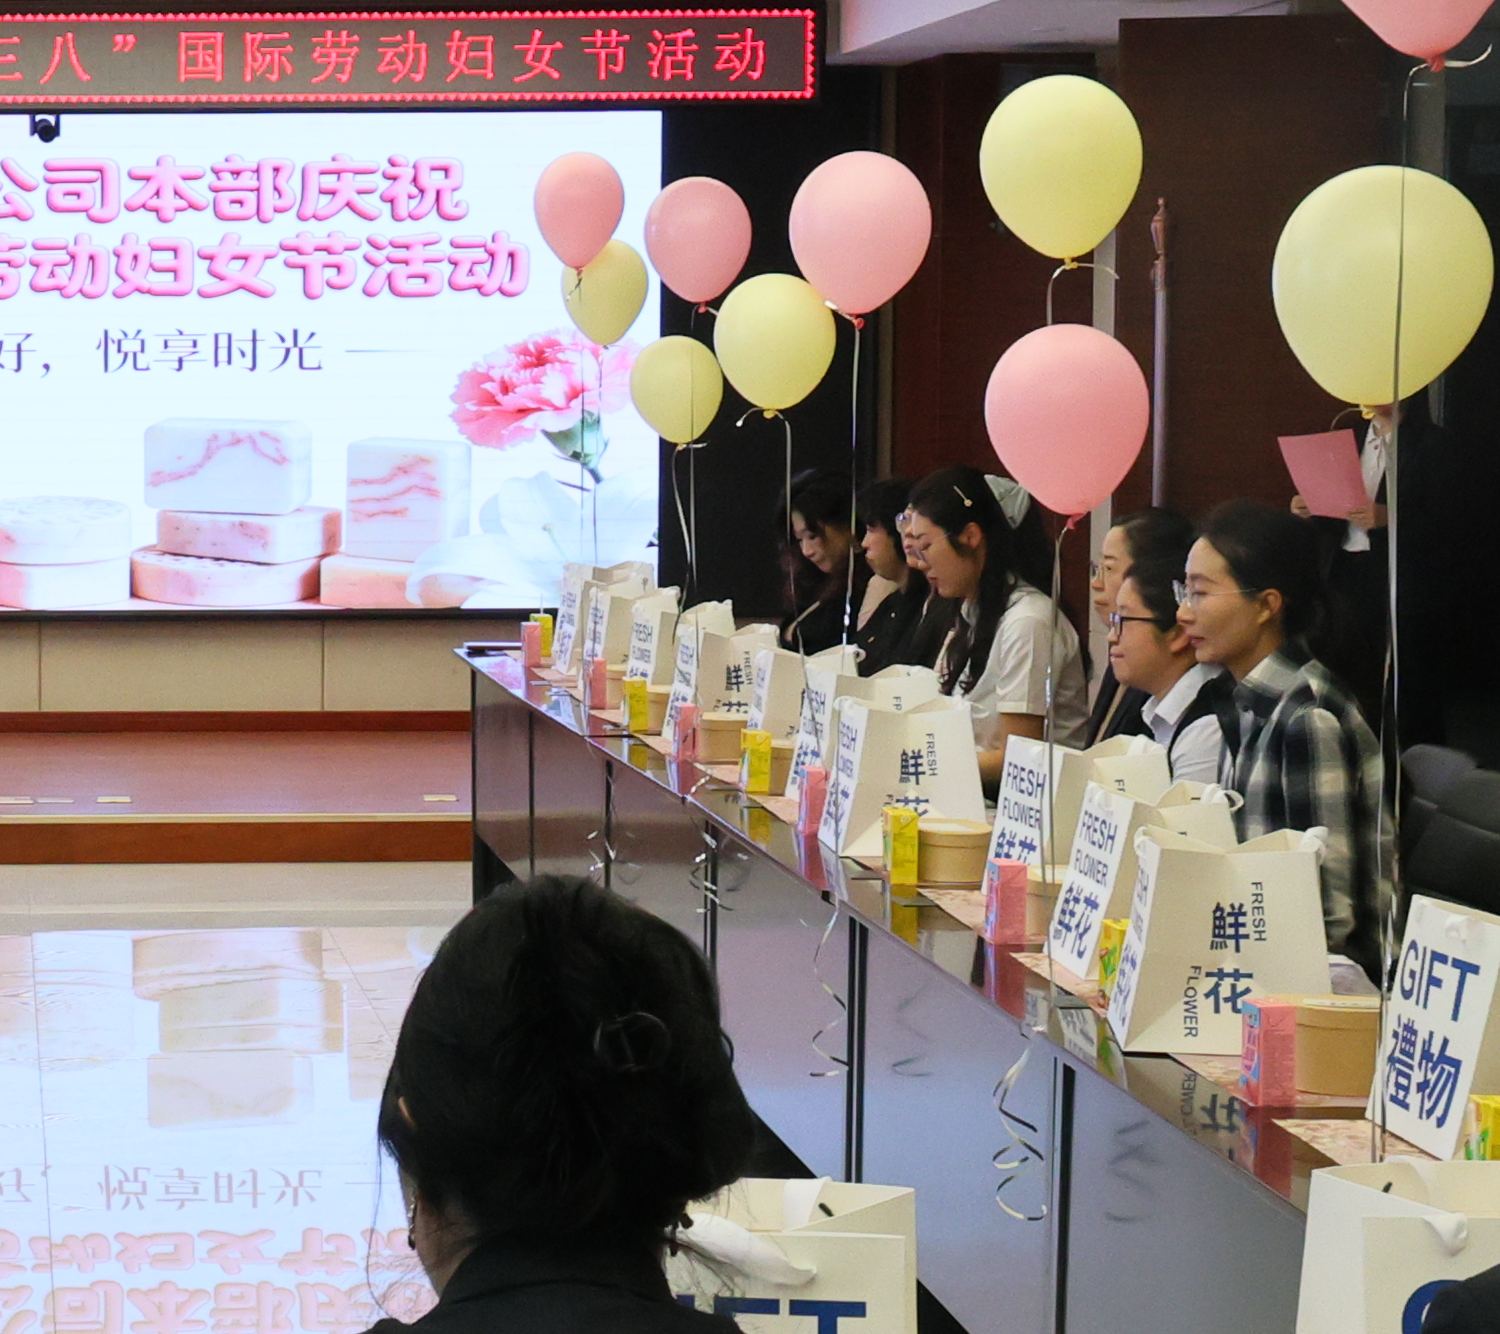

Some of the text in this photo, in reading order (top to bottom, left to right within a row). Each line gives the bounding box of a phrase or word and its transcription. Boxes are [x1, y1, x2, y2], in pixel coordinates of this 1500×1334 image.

[925, 731, 939, 778] FRESH
[1004, 761, 1047, 800] FRESH
[1001, 796, 1042, 829] FLOWER
[1080, 809, 1119, 856] FRESH
[1073, 847, 1109, 889] FLOWER
[1052, 880, 1100, 961] 鮮花
[1250, 880, 1267, 943] FRESH
[1203, 901, 1254, 1015] 鮮花
[1399, 938, 1481, 1023] GIFT
[1183, 964, 1203, 1039] FLOWER
[1385, 1012, 1464, 1130] 禮物
